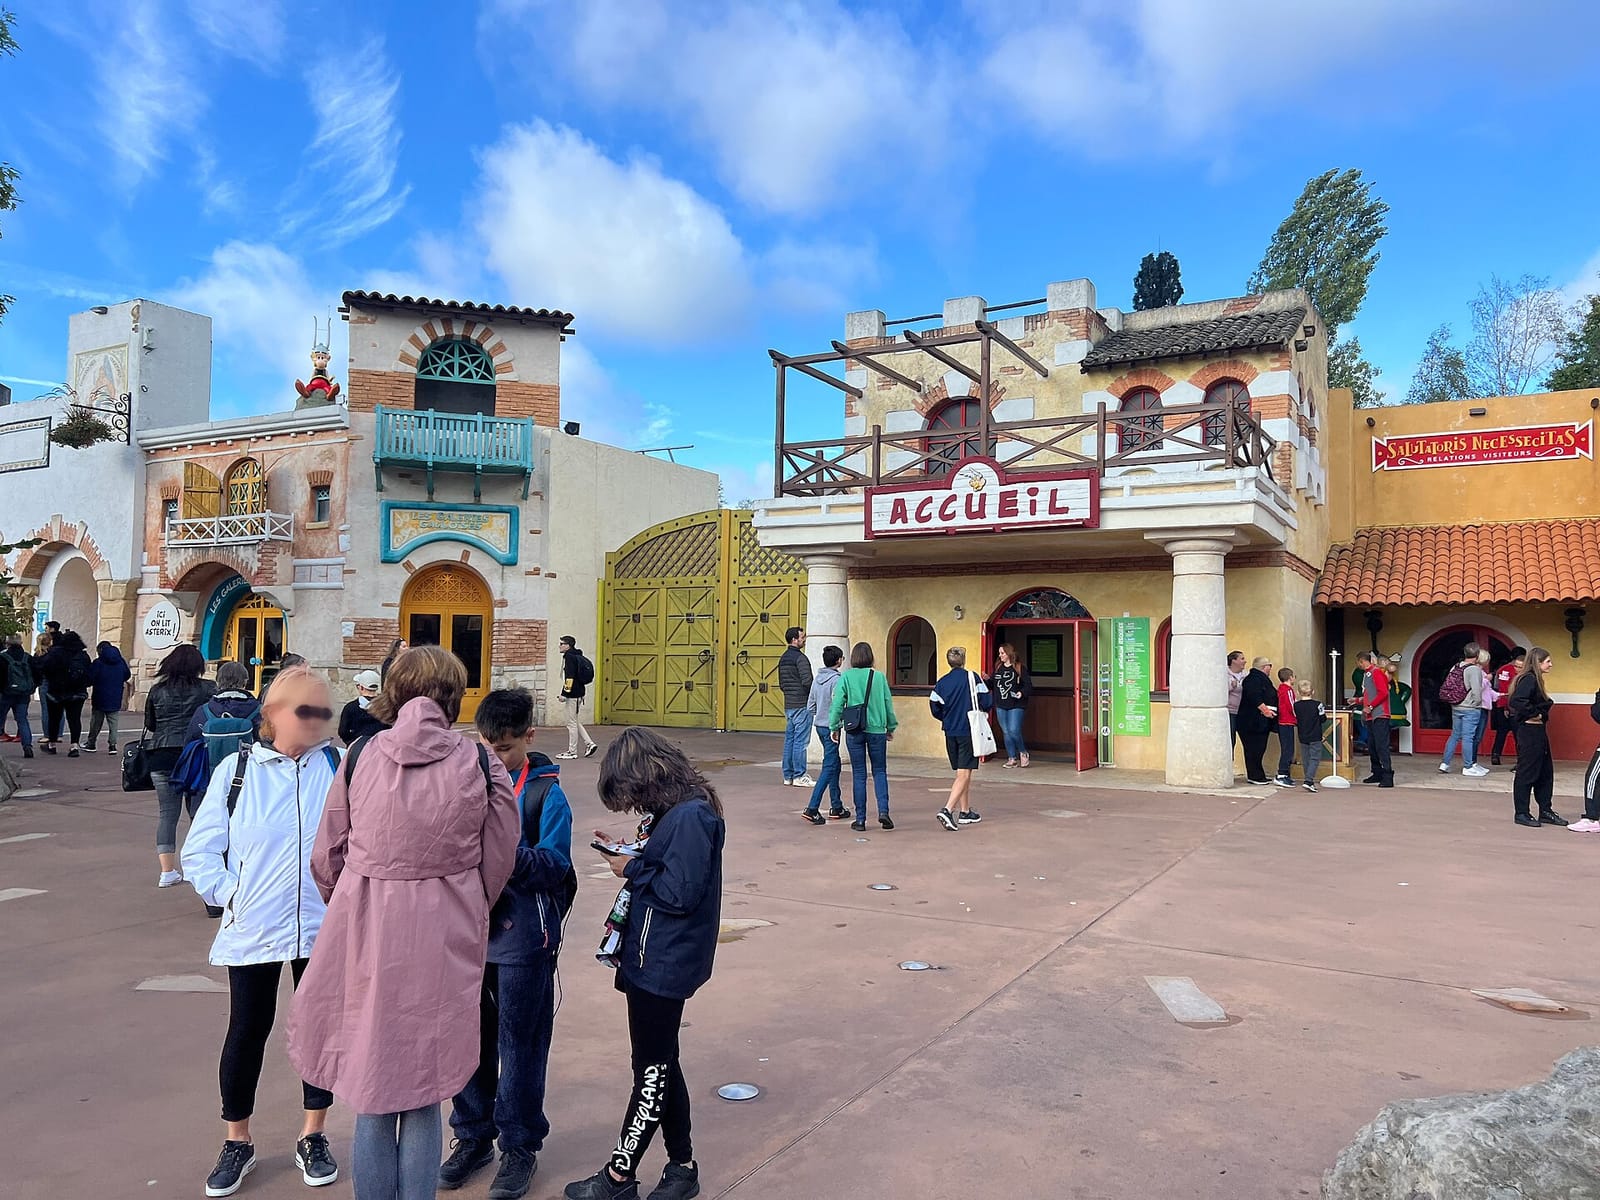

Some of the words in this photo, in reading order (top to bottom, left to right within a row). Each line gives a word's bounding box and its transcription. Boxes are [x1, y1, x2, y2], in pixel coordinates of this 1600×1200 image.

[1427, 454, 1476, 462] RELATIONS
[1483, 450, 1532, 458] VISITEURS
[411, 512, 432, 520] LES
[436, 512, 489, 522] GALERIES
[209, 595, 221, 614] LES
[655, 1064, 667, 1112] PARIS
